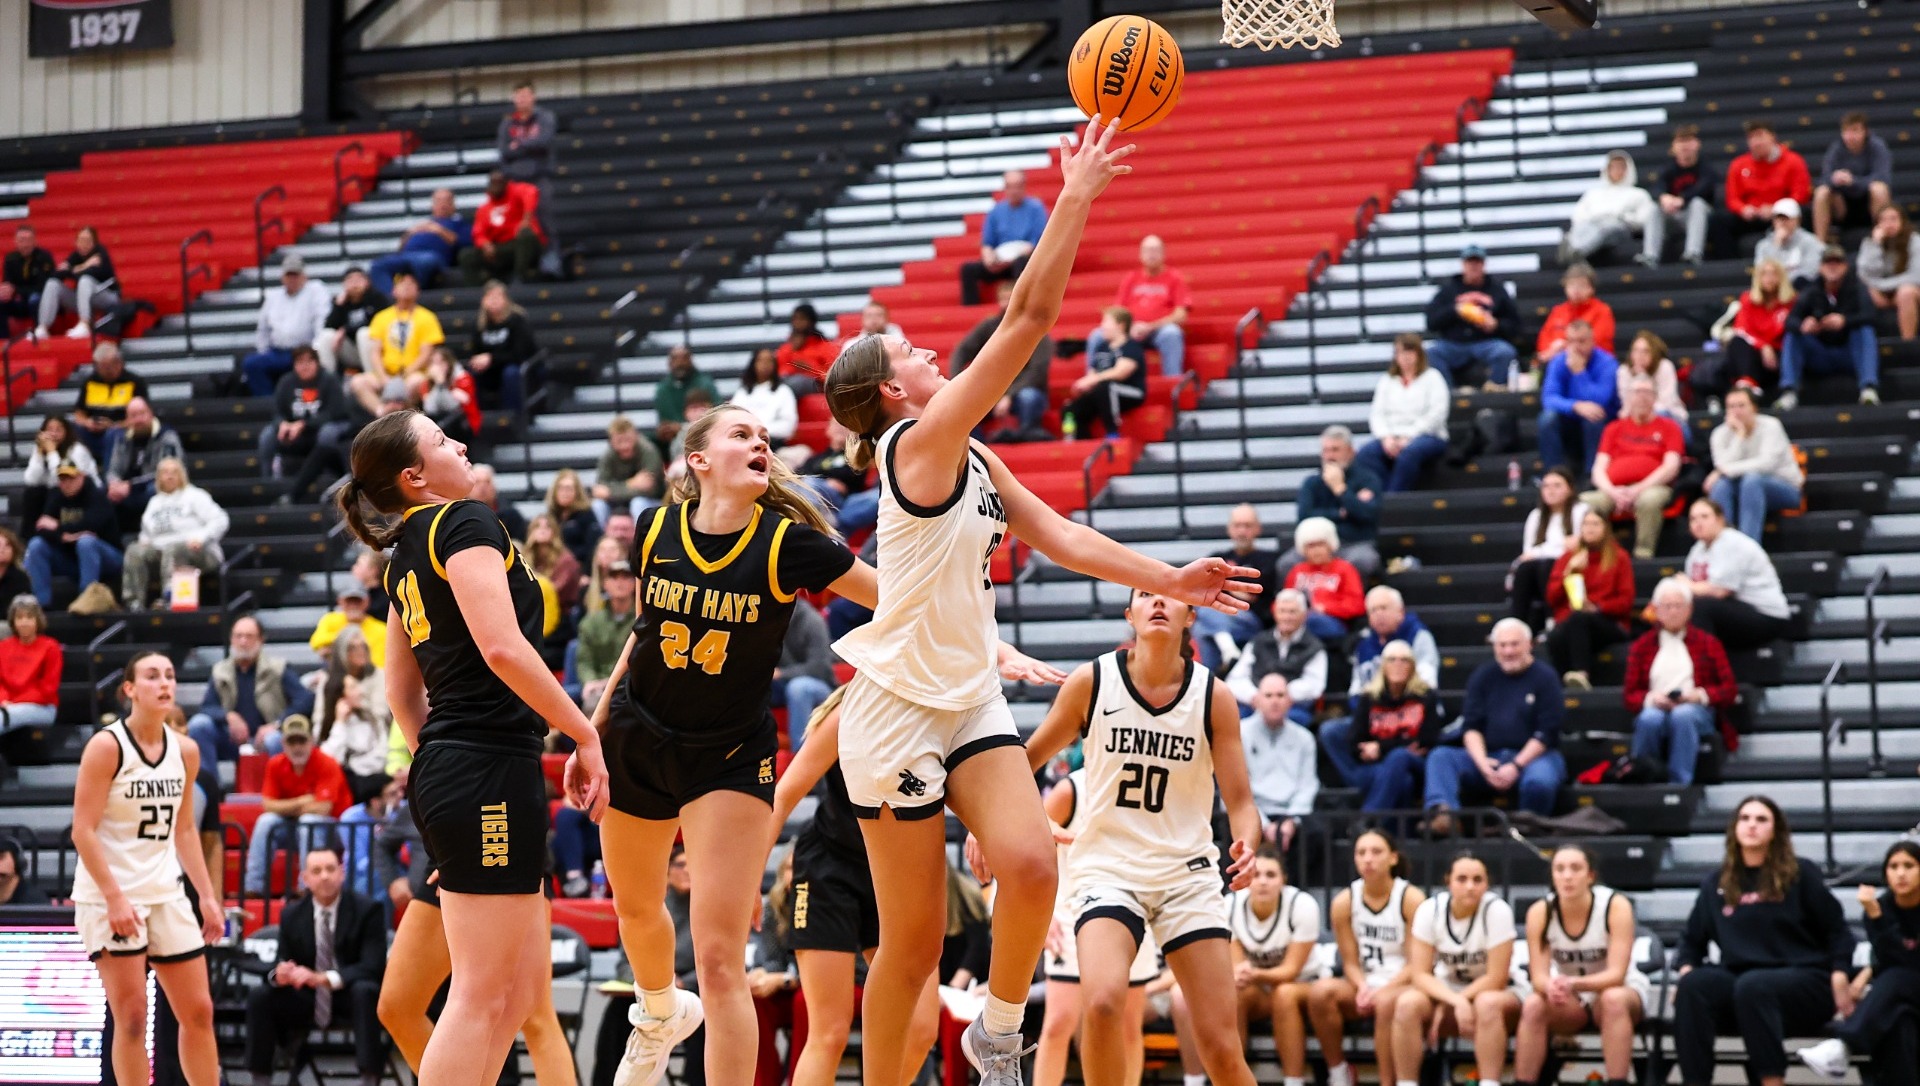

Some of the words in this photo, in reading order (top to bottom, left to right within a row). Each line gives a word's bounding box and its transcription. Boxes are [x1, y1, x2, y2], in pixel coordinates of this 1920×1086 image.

[69, 9, 141, 48] 1937
[1102, 26, 1142, 96] Wilson
[397, 569, 432, 649] 10
[645, 575, 699, 615] FORT
[701, 588, 761, 623] HAYS
[660, 620, 731, 675] 24
[1105, 727, 1196, 762] JENNIES
[124, 778, 182, 799] JENNIES
[1115, 762, 1170, 813] 20
[137, 804, 174, 841] 23
[481, 801, 509, 867] TIGERS
[1362, 944, 1384, 973] 21
